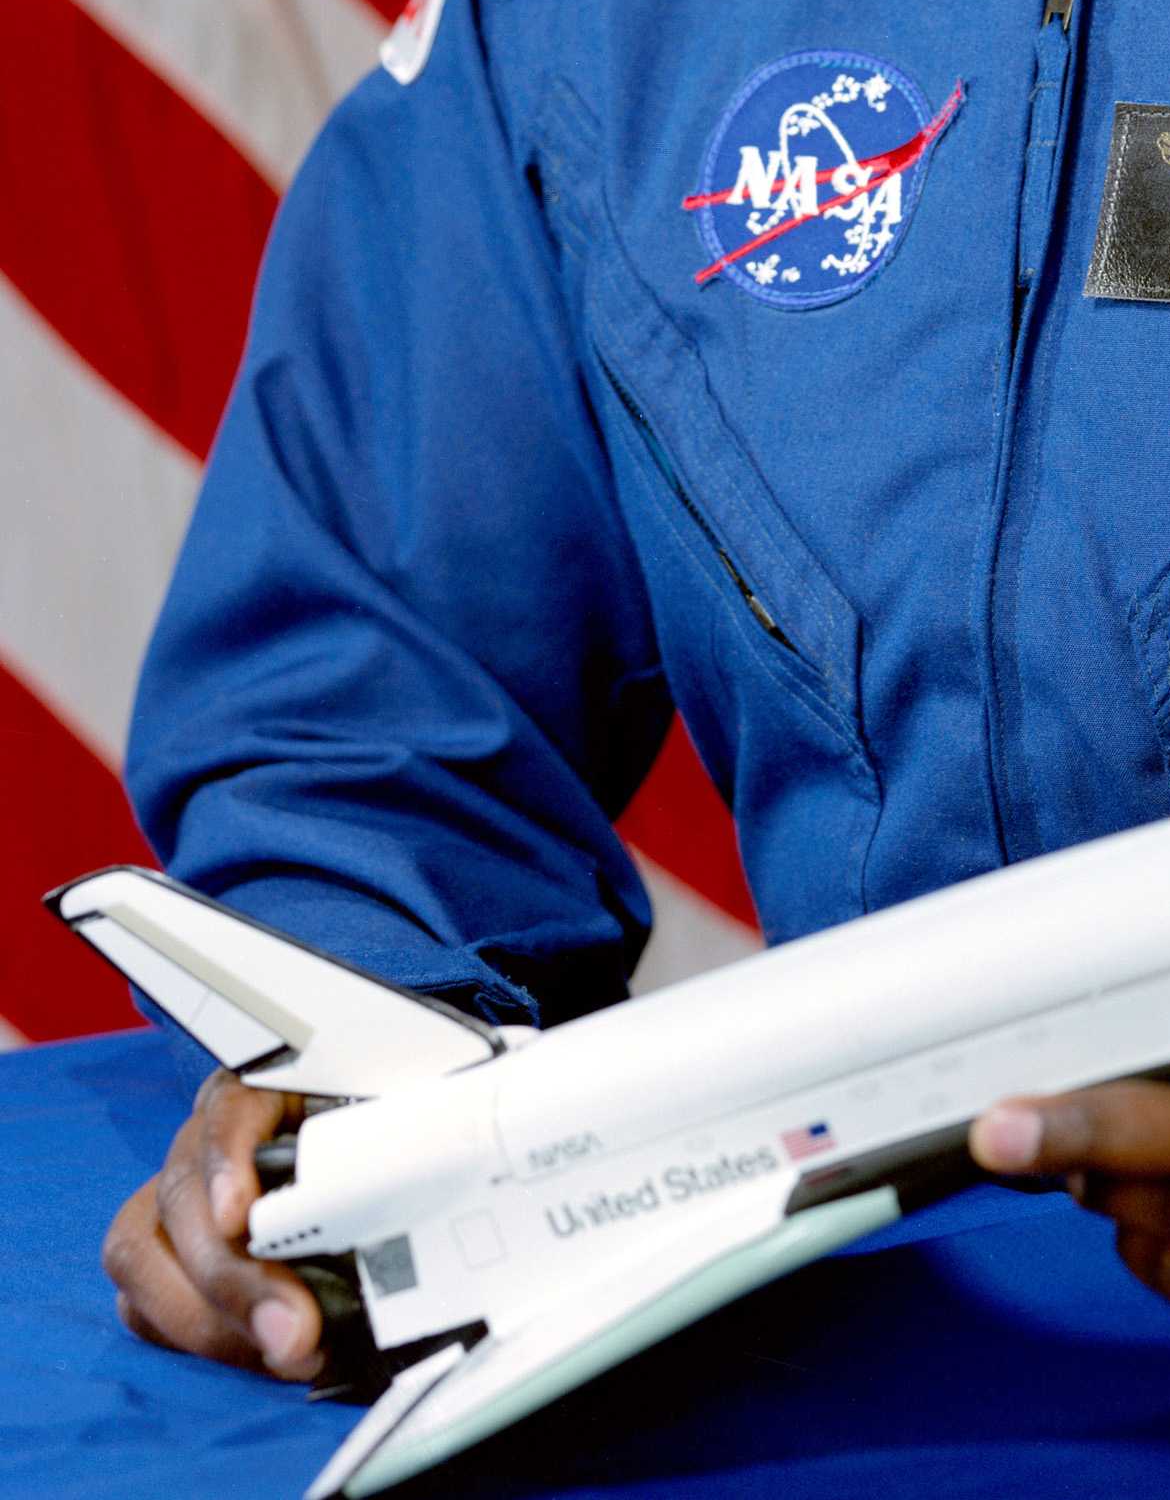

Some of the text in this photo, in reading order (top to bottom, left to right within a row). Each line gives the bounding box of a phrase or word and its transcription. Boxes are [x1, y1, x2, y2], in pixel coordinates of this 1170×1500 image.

[727, 146, 902, 225] NASA
[546, 1147, 778, 1239] United States
